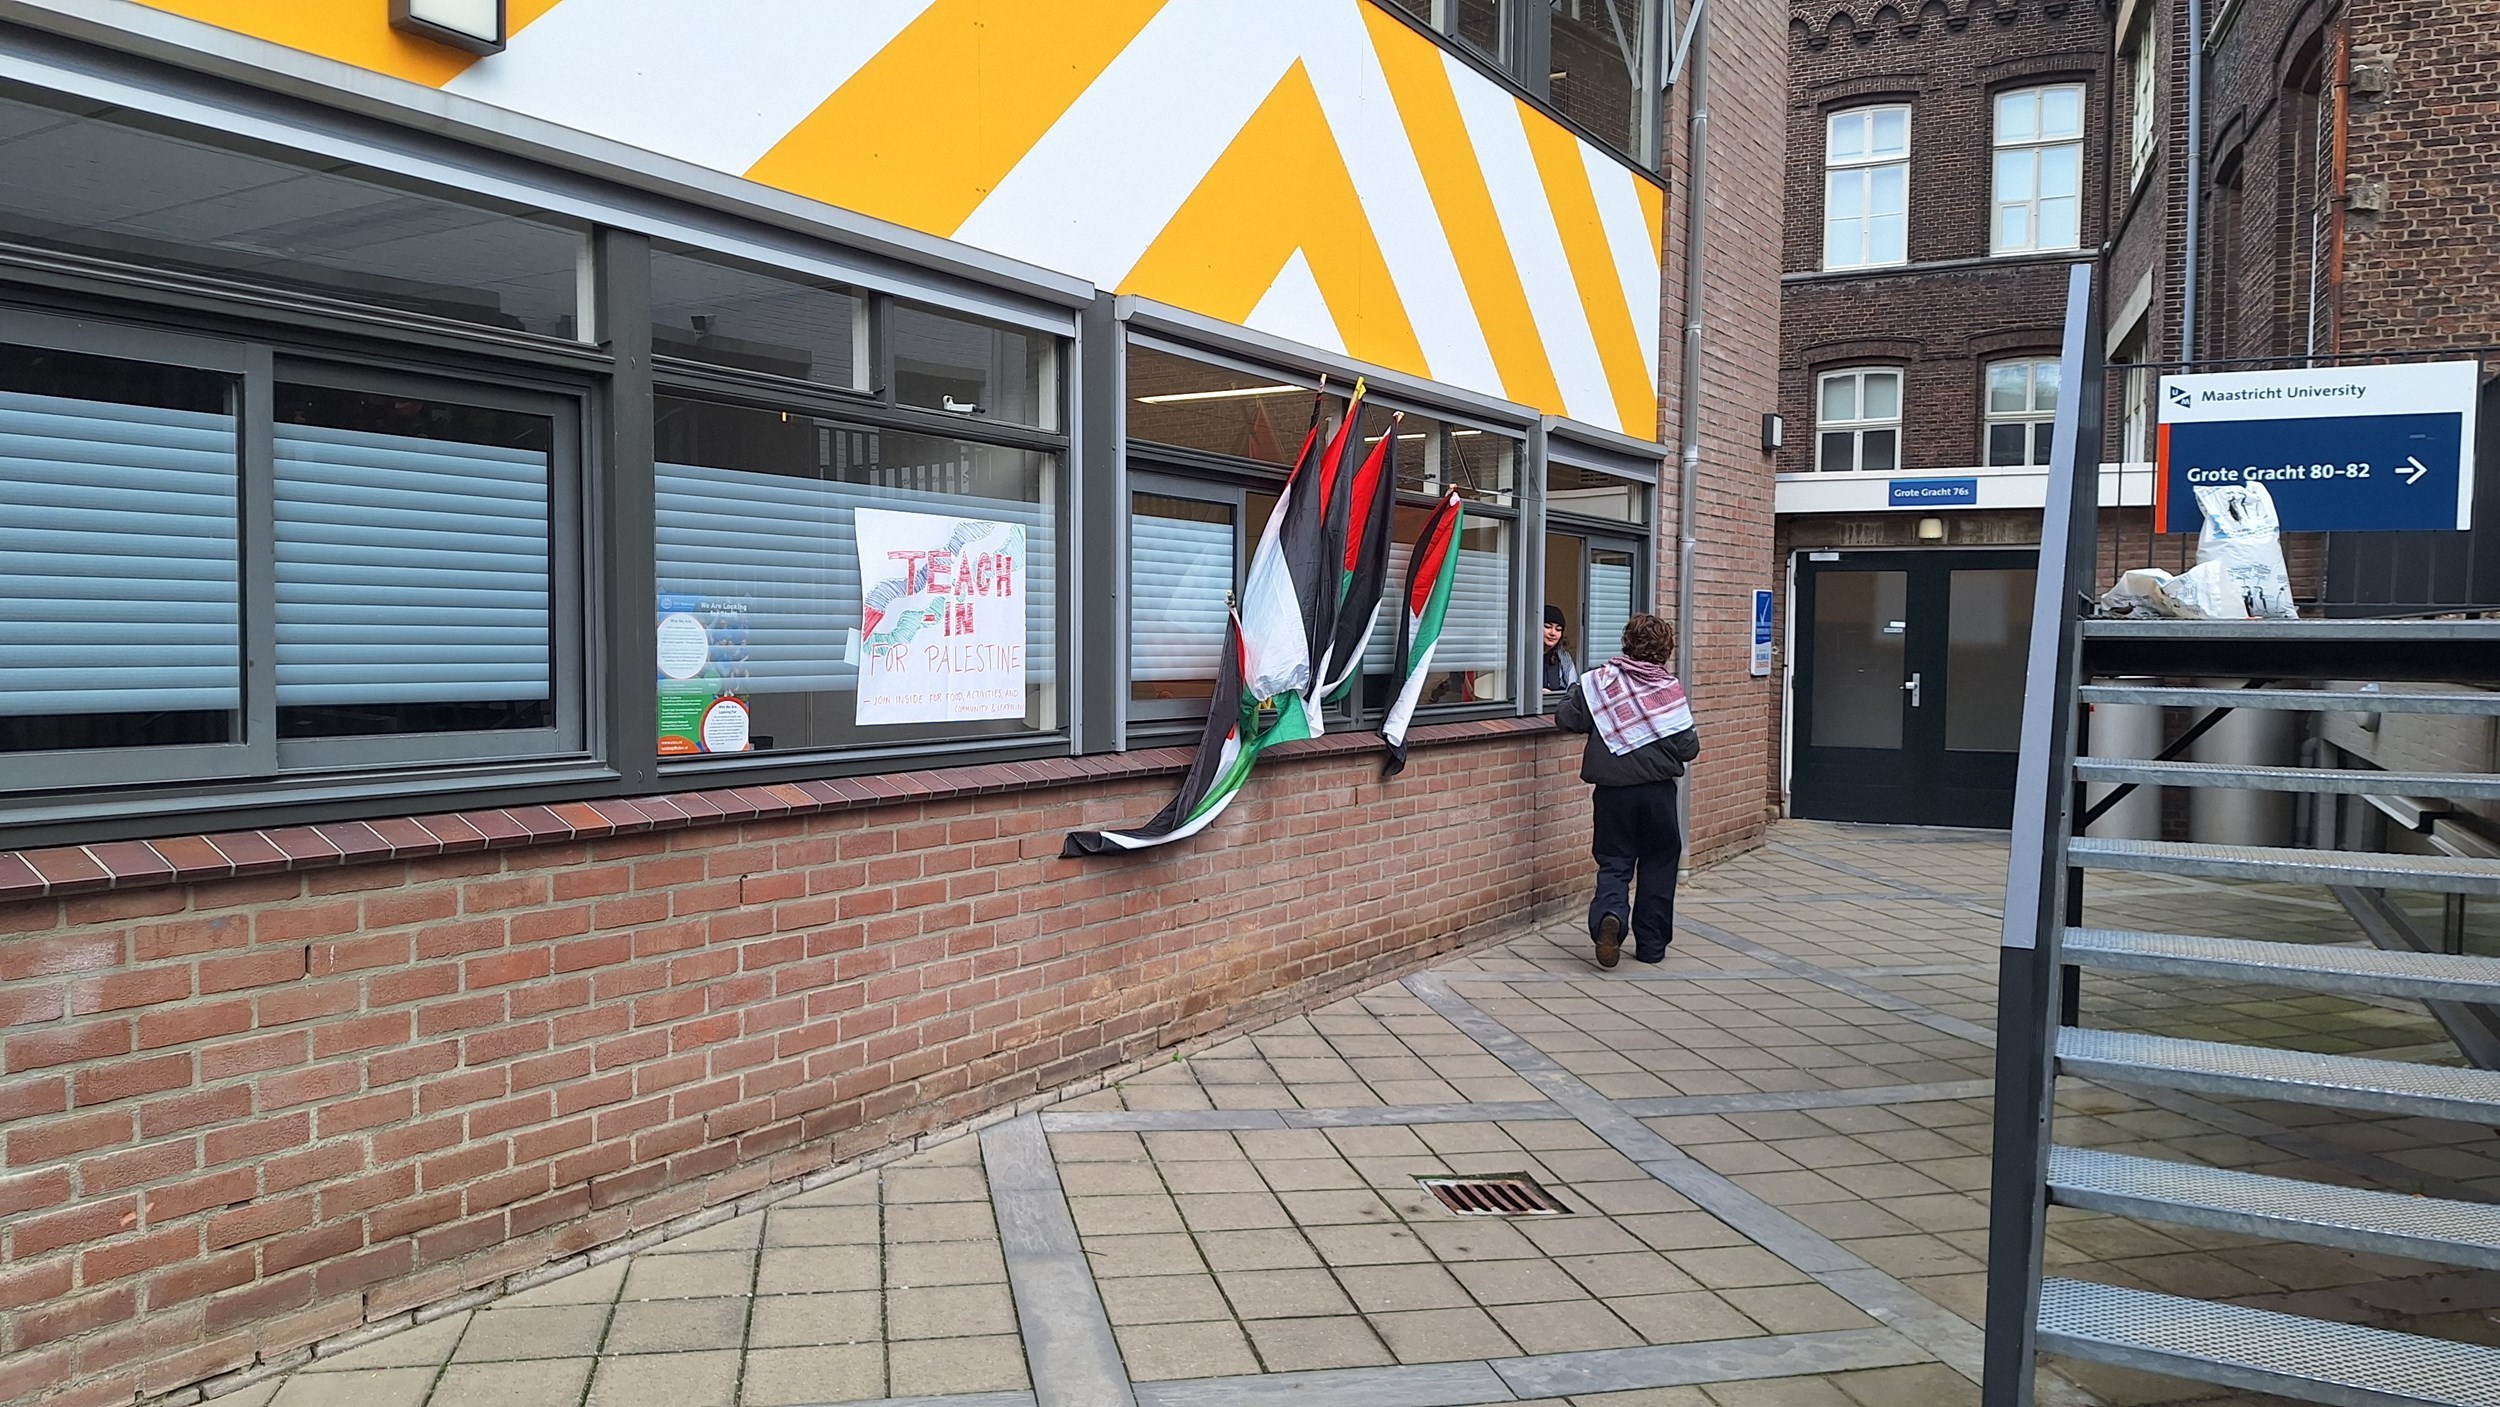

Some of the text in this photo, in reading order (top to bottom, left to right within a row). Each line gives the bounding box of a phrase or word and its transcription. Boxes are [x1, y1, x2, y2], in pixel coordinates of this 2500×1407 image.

[2201, 384, 2367, 402] Maastricht University
[2187, 467, 2238, 483] Grote
[2243, 464, 2306, 480] Gracht
[1894, 487, 1969, 497] Grote Gracht 76s
[887, 550, 1012, 598] TEACH
[710, 602, 721, 610] Are
[723, 603, 748, 613] Looking
[871, 643, 1021, 677] FOR PALESTINE
[874, 695, 891, 706] JOIN
[895, 694, 924, 704] INSIDE
[929, 693, 942, 702] FOR
[1004, 689, 1019, 698] AND
[954, 703, 988, 713] COMMUNITY
